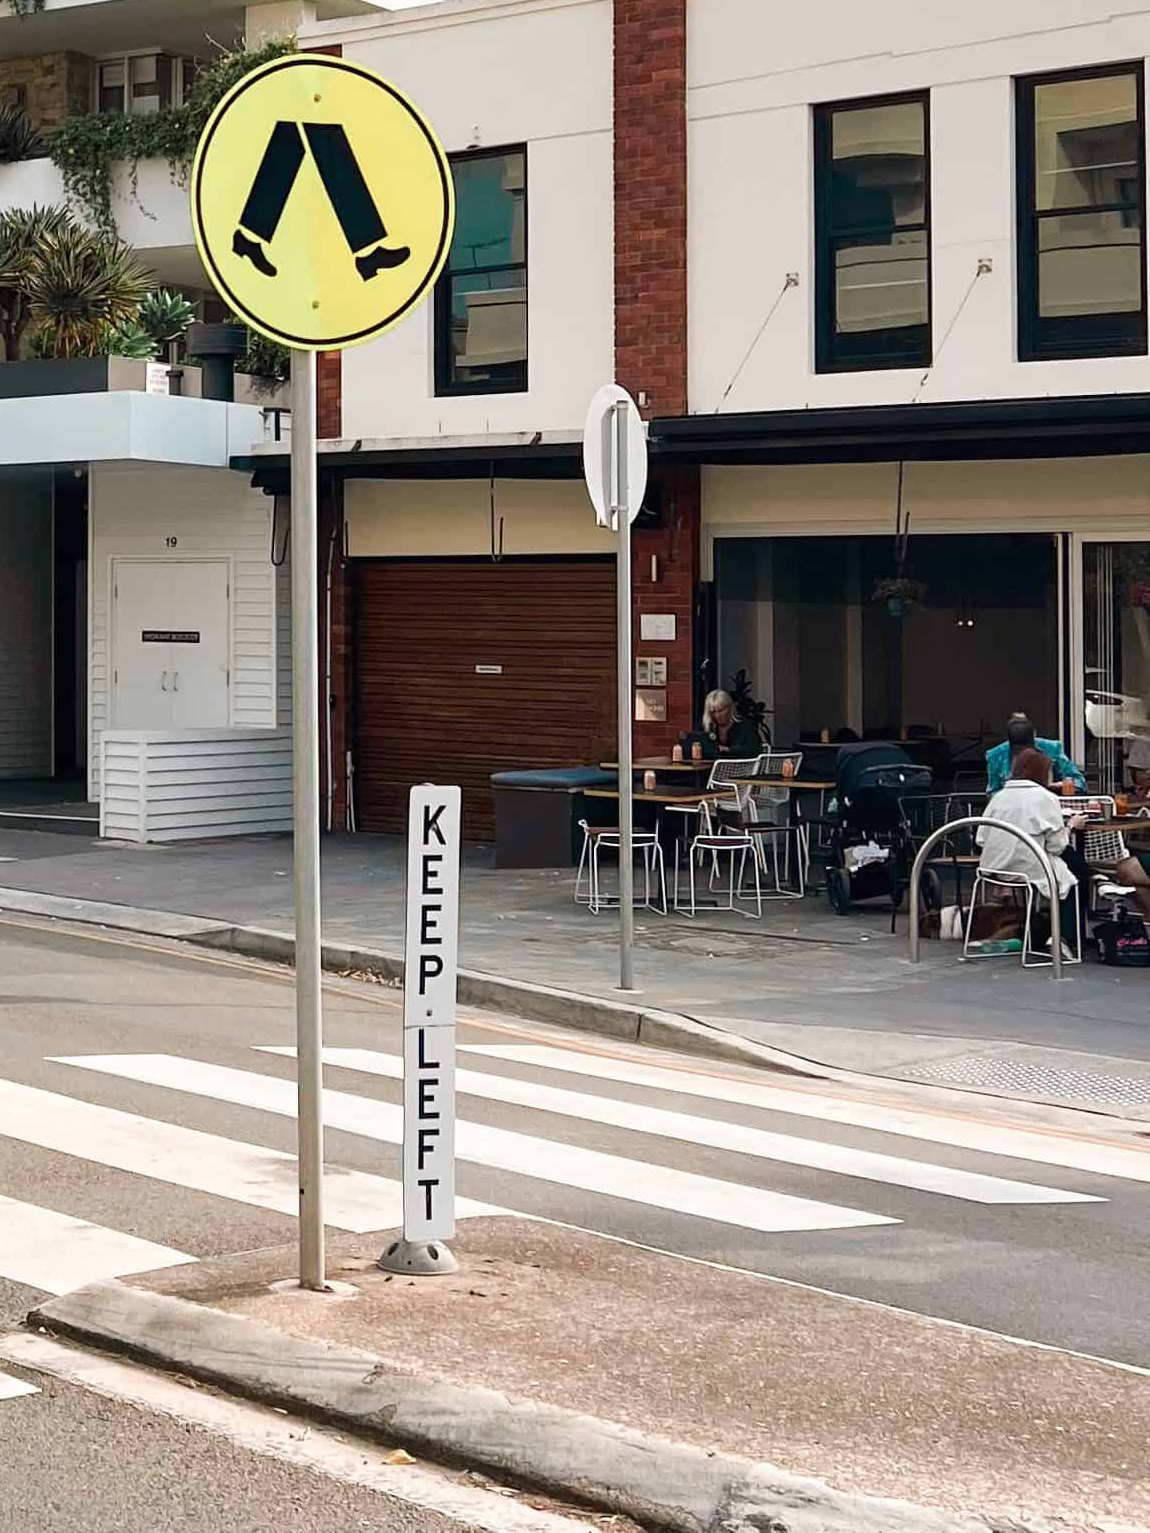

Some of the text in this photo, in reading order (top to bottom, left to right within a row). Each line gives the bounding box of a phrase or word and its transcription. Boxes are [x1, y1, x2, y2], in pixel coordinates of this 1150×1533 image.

[166, 537, 178, 548] 19
[417, 804, 447, 1220] KEEP LEFT
